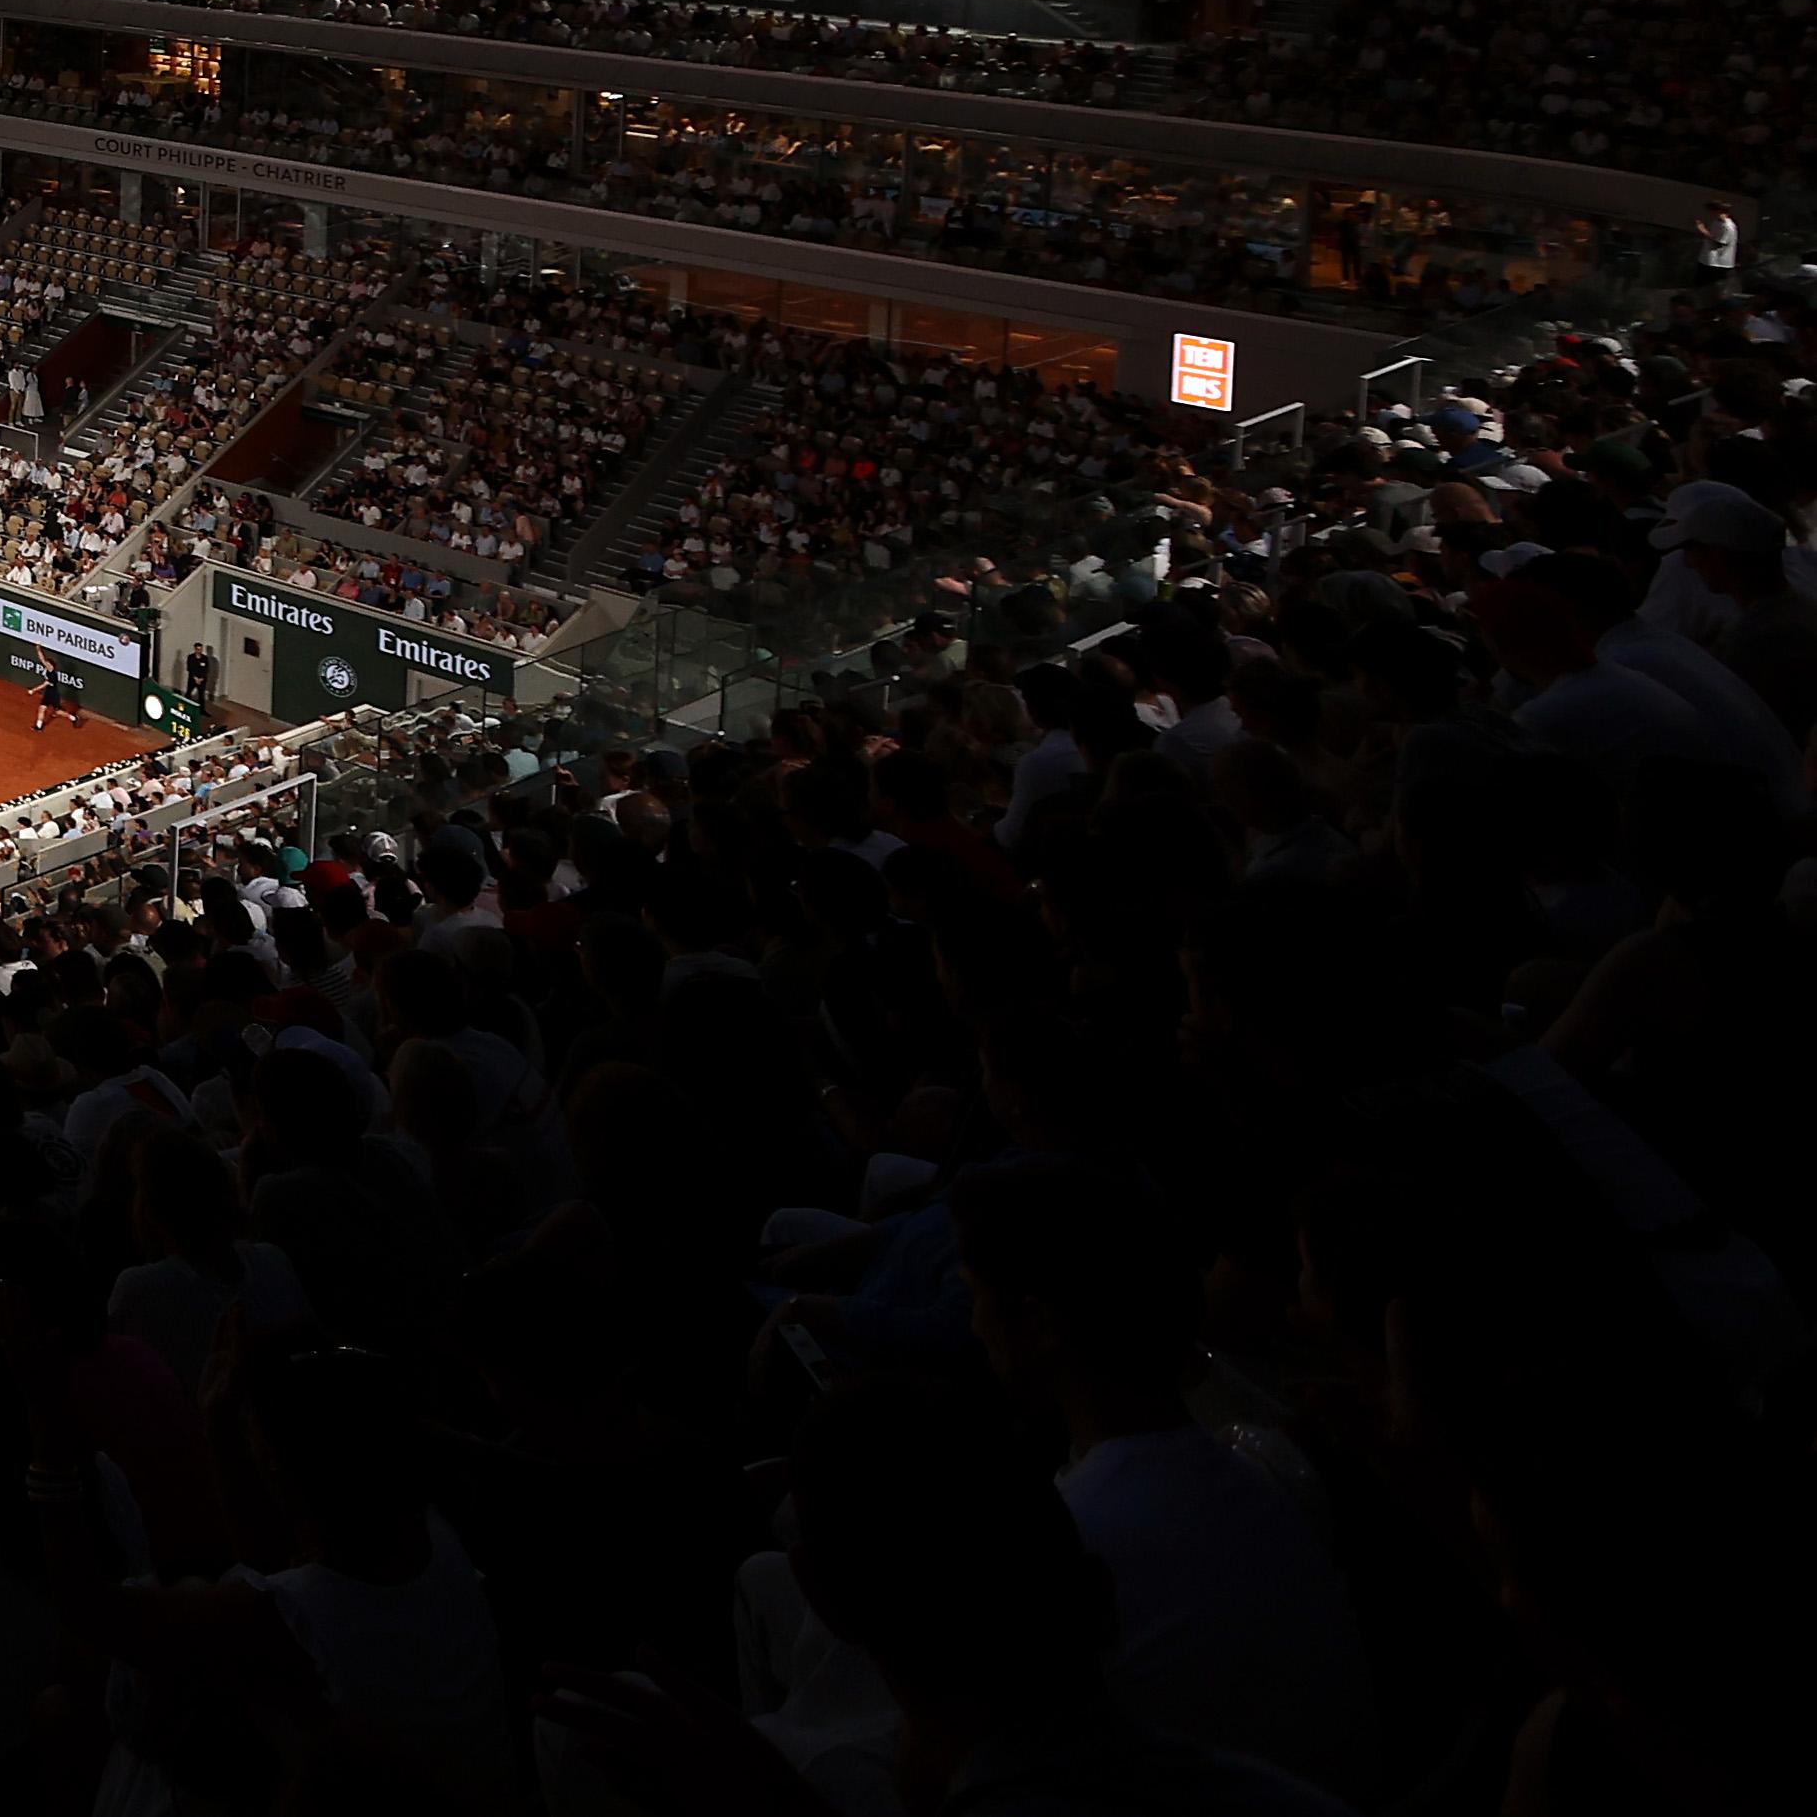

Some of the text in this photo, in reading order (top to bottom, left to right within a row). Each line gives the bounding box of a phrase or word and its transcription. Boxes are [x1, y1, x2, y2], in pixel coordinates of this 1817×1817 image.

[94, 136, 153, 159] COURT
[158, 142, 236, 173] PHILIPPE
[252, 162, 346, 192] CHATRIER
[1181, 345, 1224, 370] TEN
[1181, 375, 1222, 400] NIS
[230, 583, 335, 635] Emirates
[26, 618, 116, 660] BNP PARIBAS
[377, 627, 492, 681] Emirates
[10, 654, 34, 672] BNP
